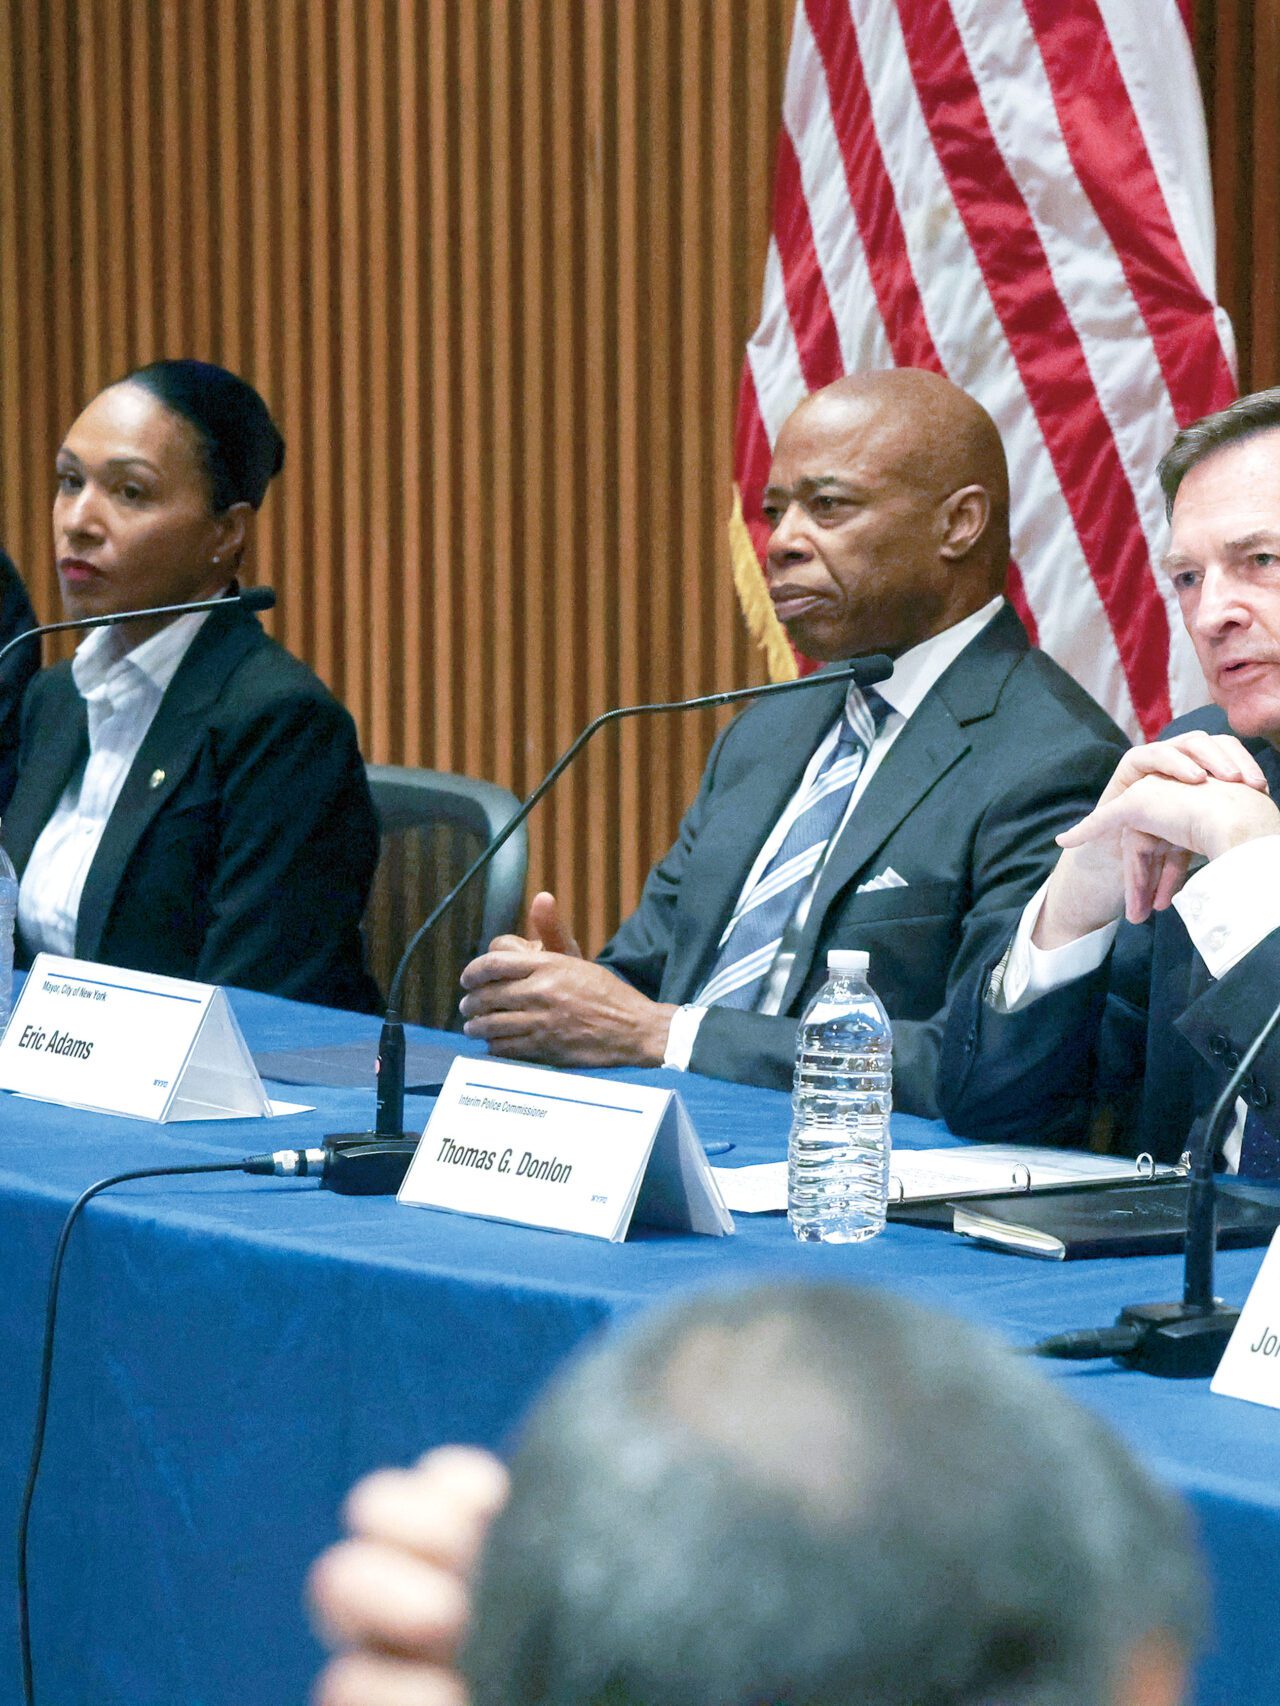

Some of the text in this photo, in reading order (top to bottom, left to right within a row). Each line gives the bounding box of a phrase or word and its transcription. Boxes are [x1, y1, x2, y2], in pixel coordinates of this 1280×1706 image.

[61, 984, 72, 997] City
[73, 987, 81, 996] of
[79, 987, 92, 998] New
[93, 989, 107, 1001] York
[19, 1025, 94, 1060] Eric Adams
[459, 1094, 548, 1118] Interim Police Commissioner
[437, 1138, 573, 1184] Thomas G. Donlon
